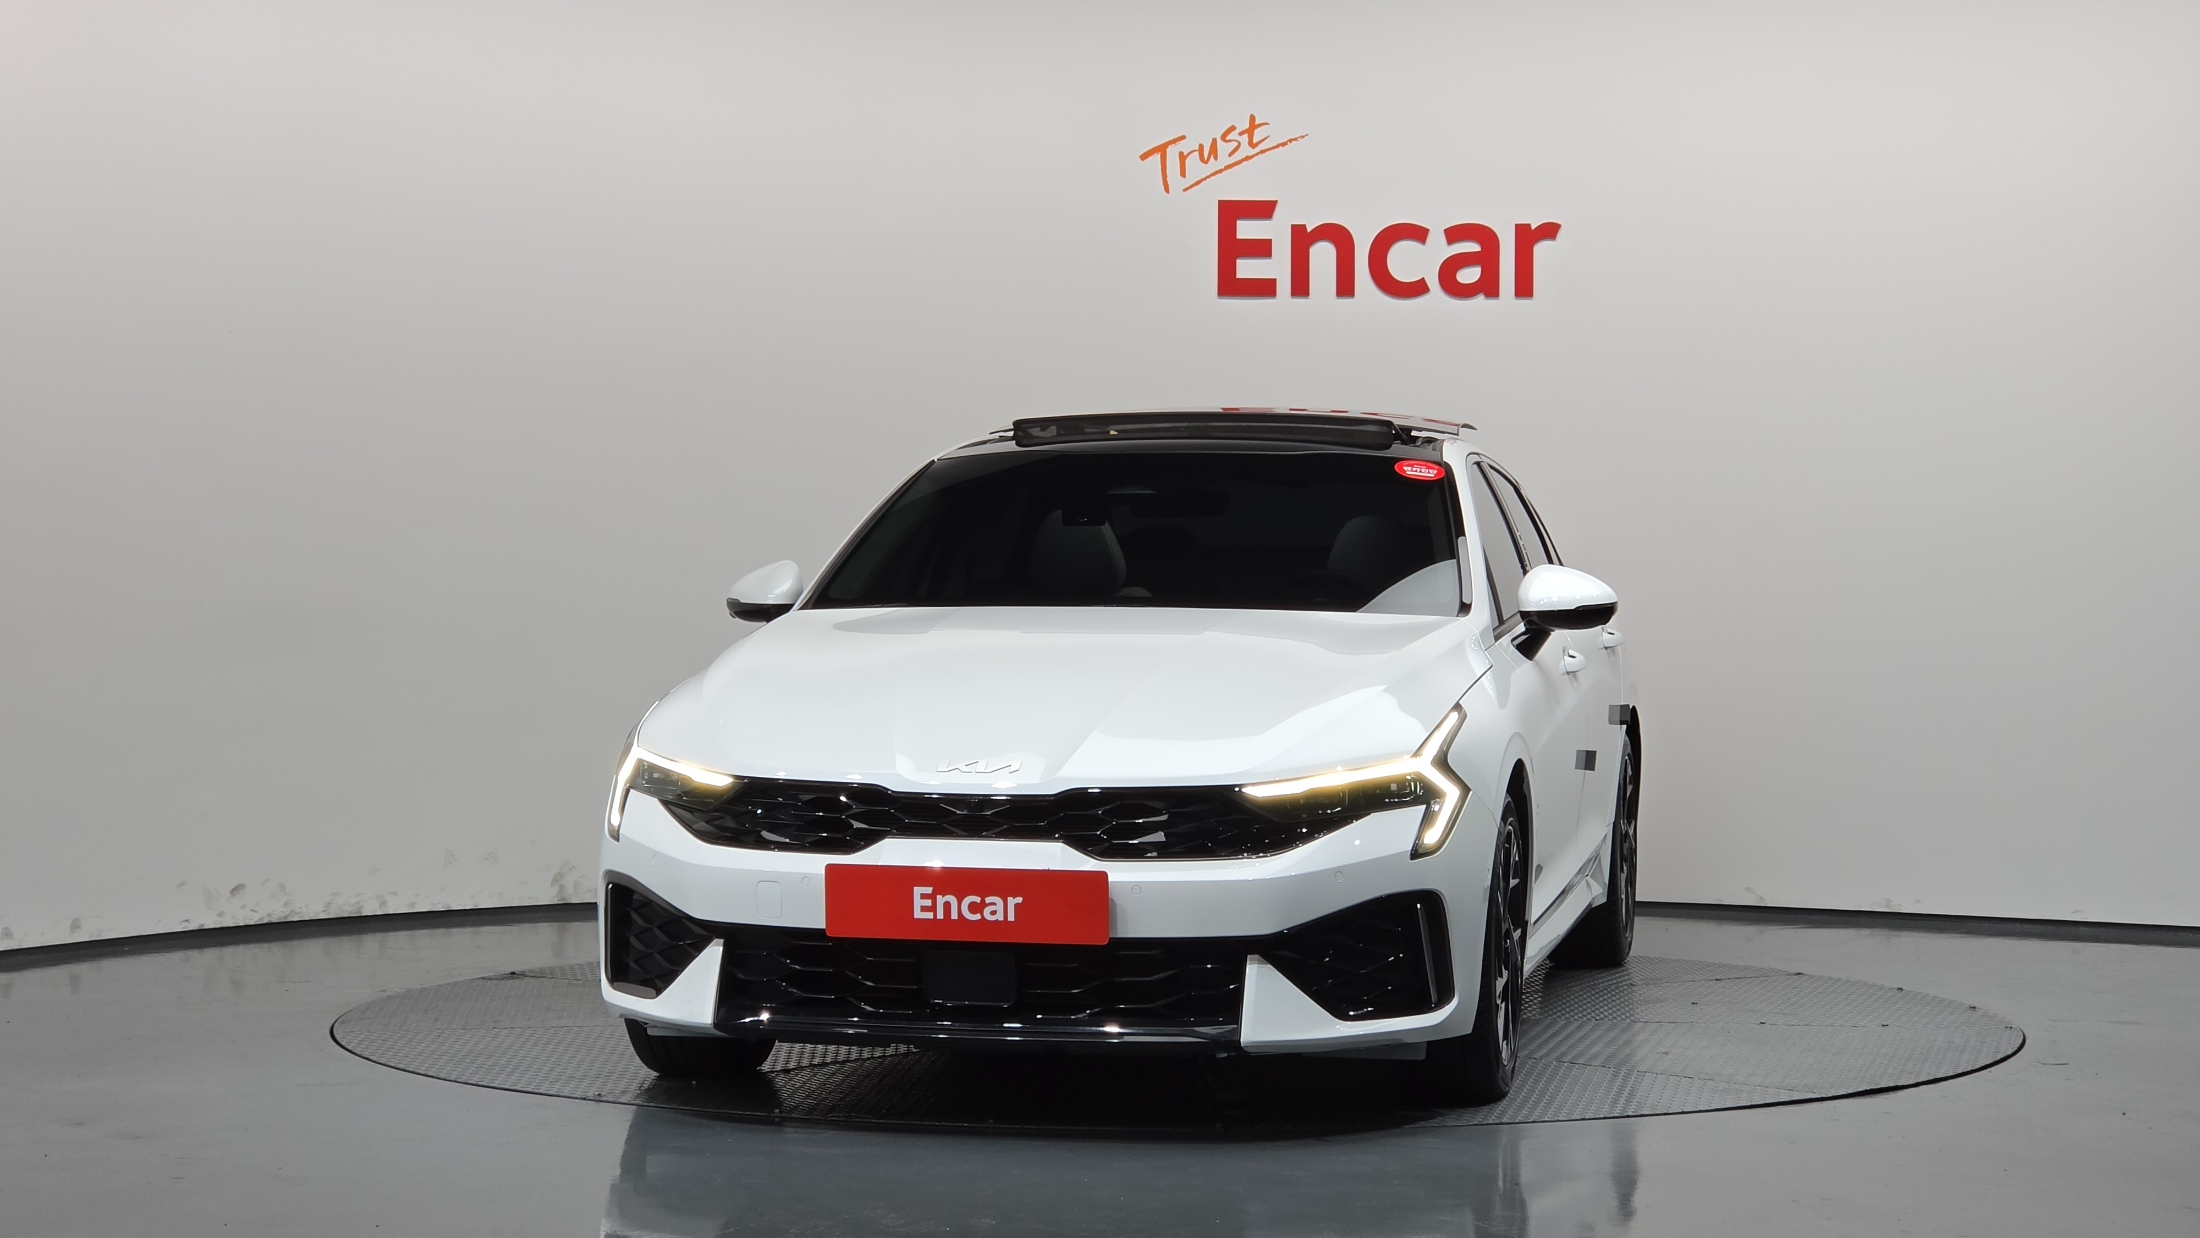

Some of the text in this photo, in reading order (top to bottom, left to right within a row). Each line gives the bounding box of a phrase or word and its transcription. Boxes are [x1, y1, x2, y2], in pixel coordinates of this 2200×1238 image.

[1139, 113, 1270, 194] Trust
[1217, 199, 1562, 299] Encar
[913, 886, 1023, 922] Encar
